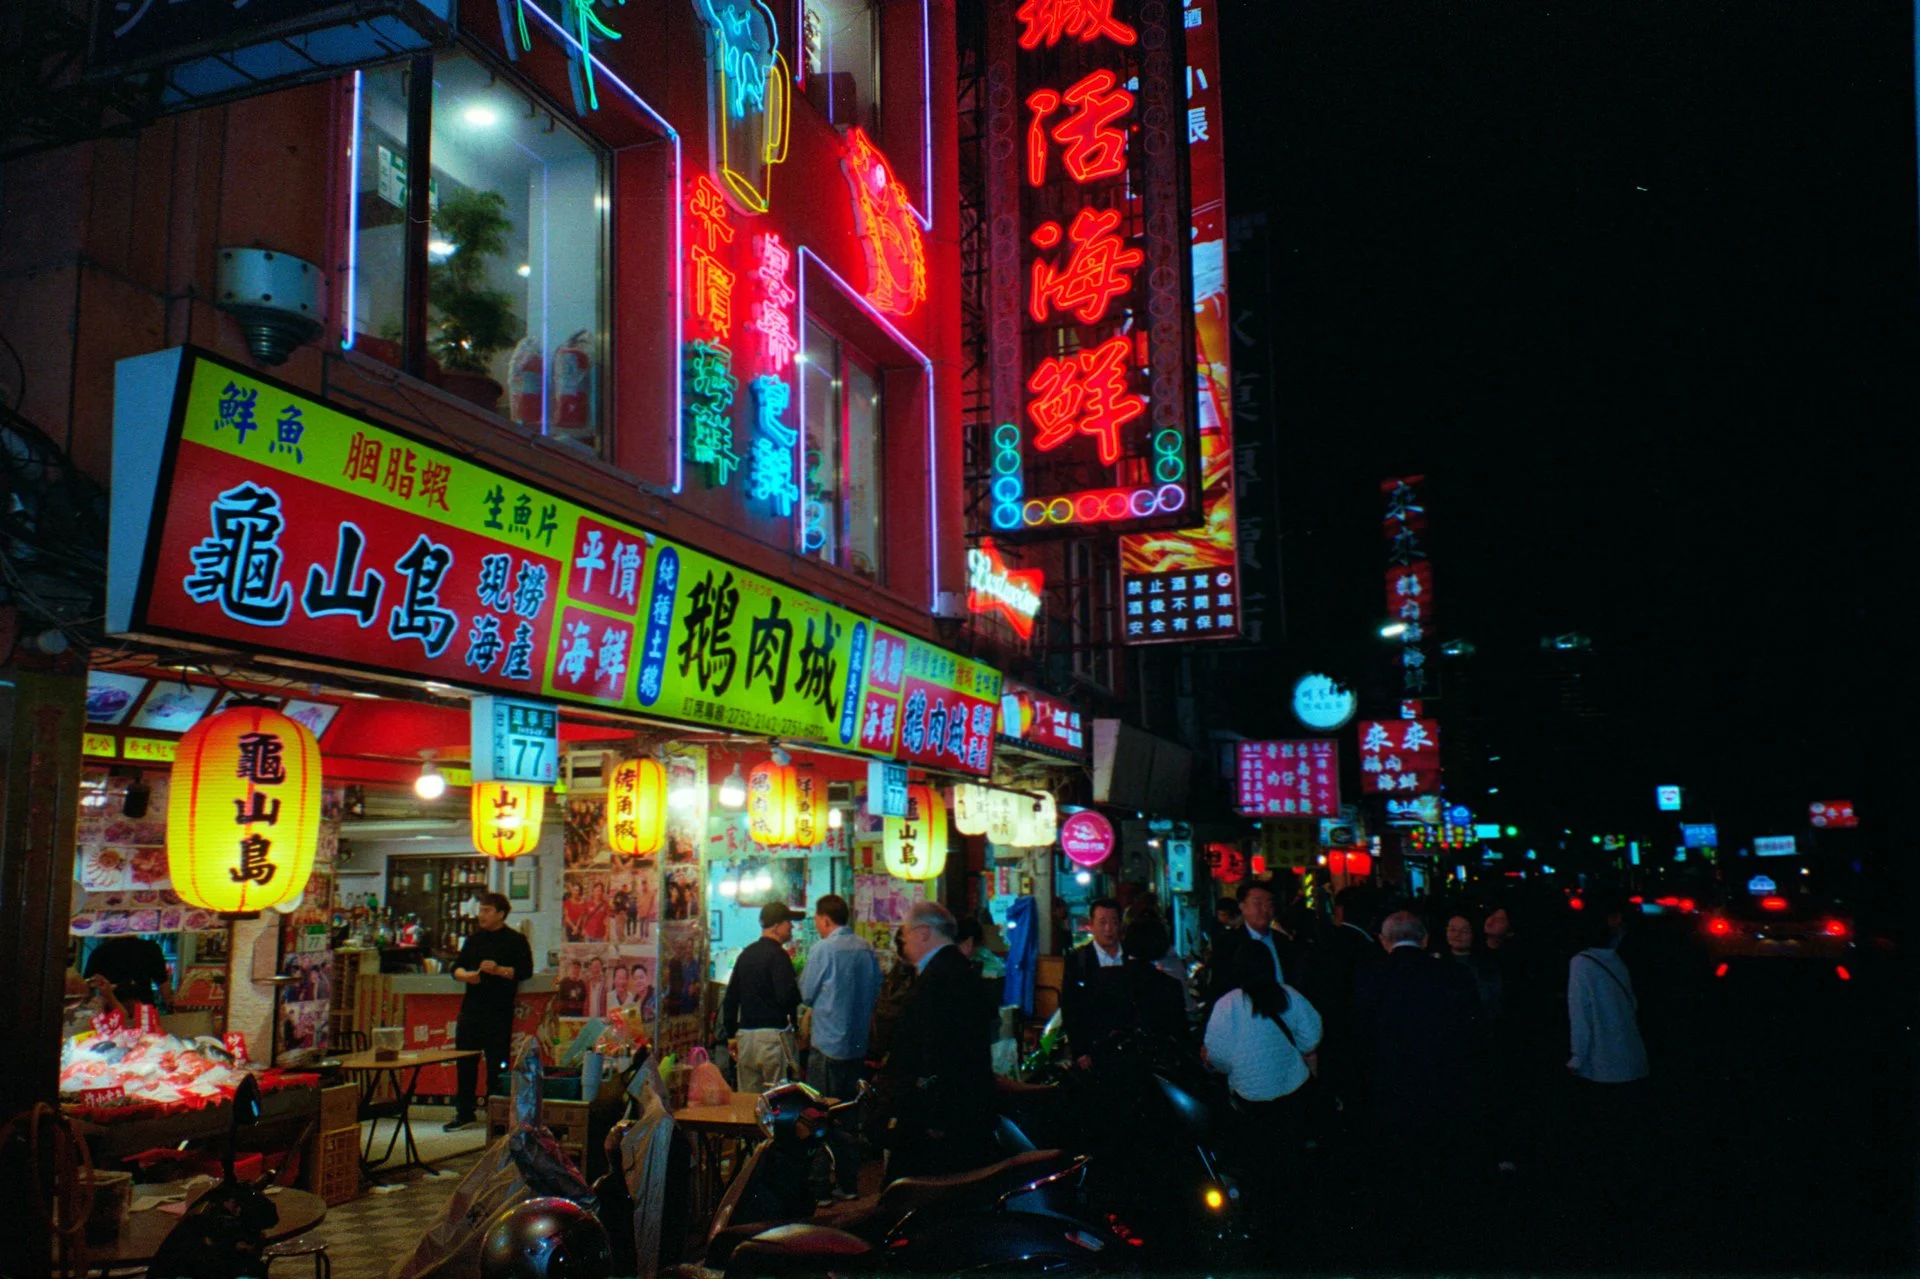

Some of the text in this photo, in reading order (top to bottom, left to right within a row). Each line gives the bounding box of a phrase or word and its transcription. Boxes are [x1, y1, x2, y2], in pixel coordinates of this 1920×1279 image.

[214, 380, 305, 464] 鮮魚
[342, 431, 452, 512] 胭脂蝦
[483, 484, 560, 548] 生魚片
[183, 480, 460, 658] 龜山島
[476, 553, 550, 617] 現撈
[577, 529, 644, 605] 平價
[466, 615, 533, 681] 海產
[556, 618, 629, 693] 海鮮
[677, 570, 843, 723] 鵝肉城
[1128, 614, 1235, 636] 安全有保障
[512, 738, 546, 777] 77
[862, 700, 896, 747] 海鮮
[902, 687, 968, 764] 鵝肉城
[1363, 721, 1435, 752] 來來
[230, 731, 286, 887] 龜山島
